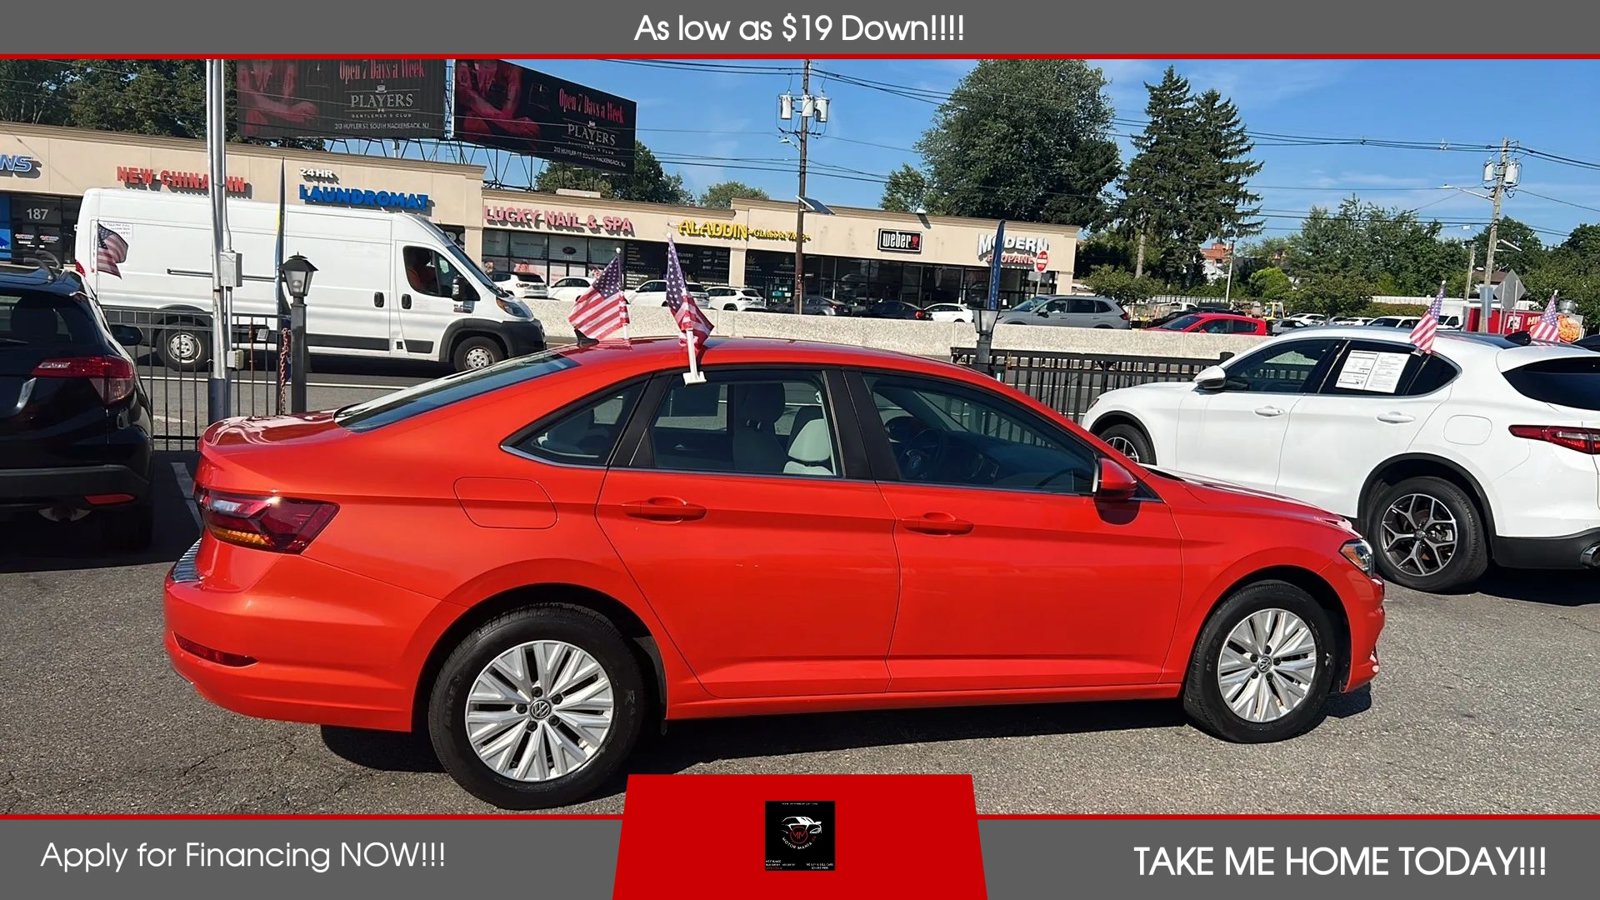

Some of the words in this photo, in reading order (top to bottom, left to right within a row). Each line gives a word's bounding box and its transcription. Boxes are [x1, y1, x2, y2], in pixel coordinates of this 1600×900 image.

[350, 93, 414, 108] PLAYERS
[559, 88, 577, 112] Open
[567, 123, 616, 146] PLAYERS
[117, 166, 154, 185] NEW
[160, 170, 209, 189] CHINA
[224, 175, 245, 193] NN
[299, 184, 429, 211] LAUNDROMAT
[26, 208, 49, 220] 187
[483, 205, 541, 223] LUCKY
[544, 211, 581, 228] NAIL
[586, 214, 598, 229] &
[602, 216, 632, 232] SPA
[677, 219, 748, 240] ALADDIN
[882, 231, 912, 249] weber
[986, 254, 1035, 265] POPANE
